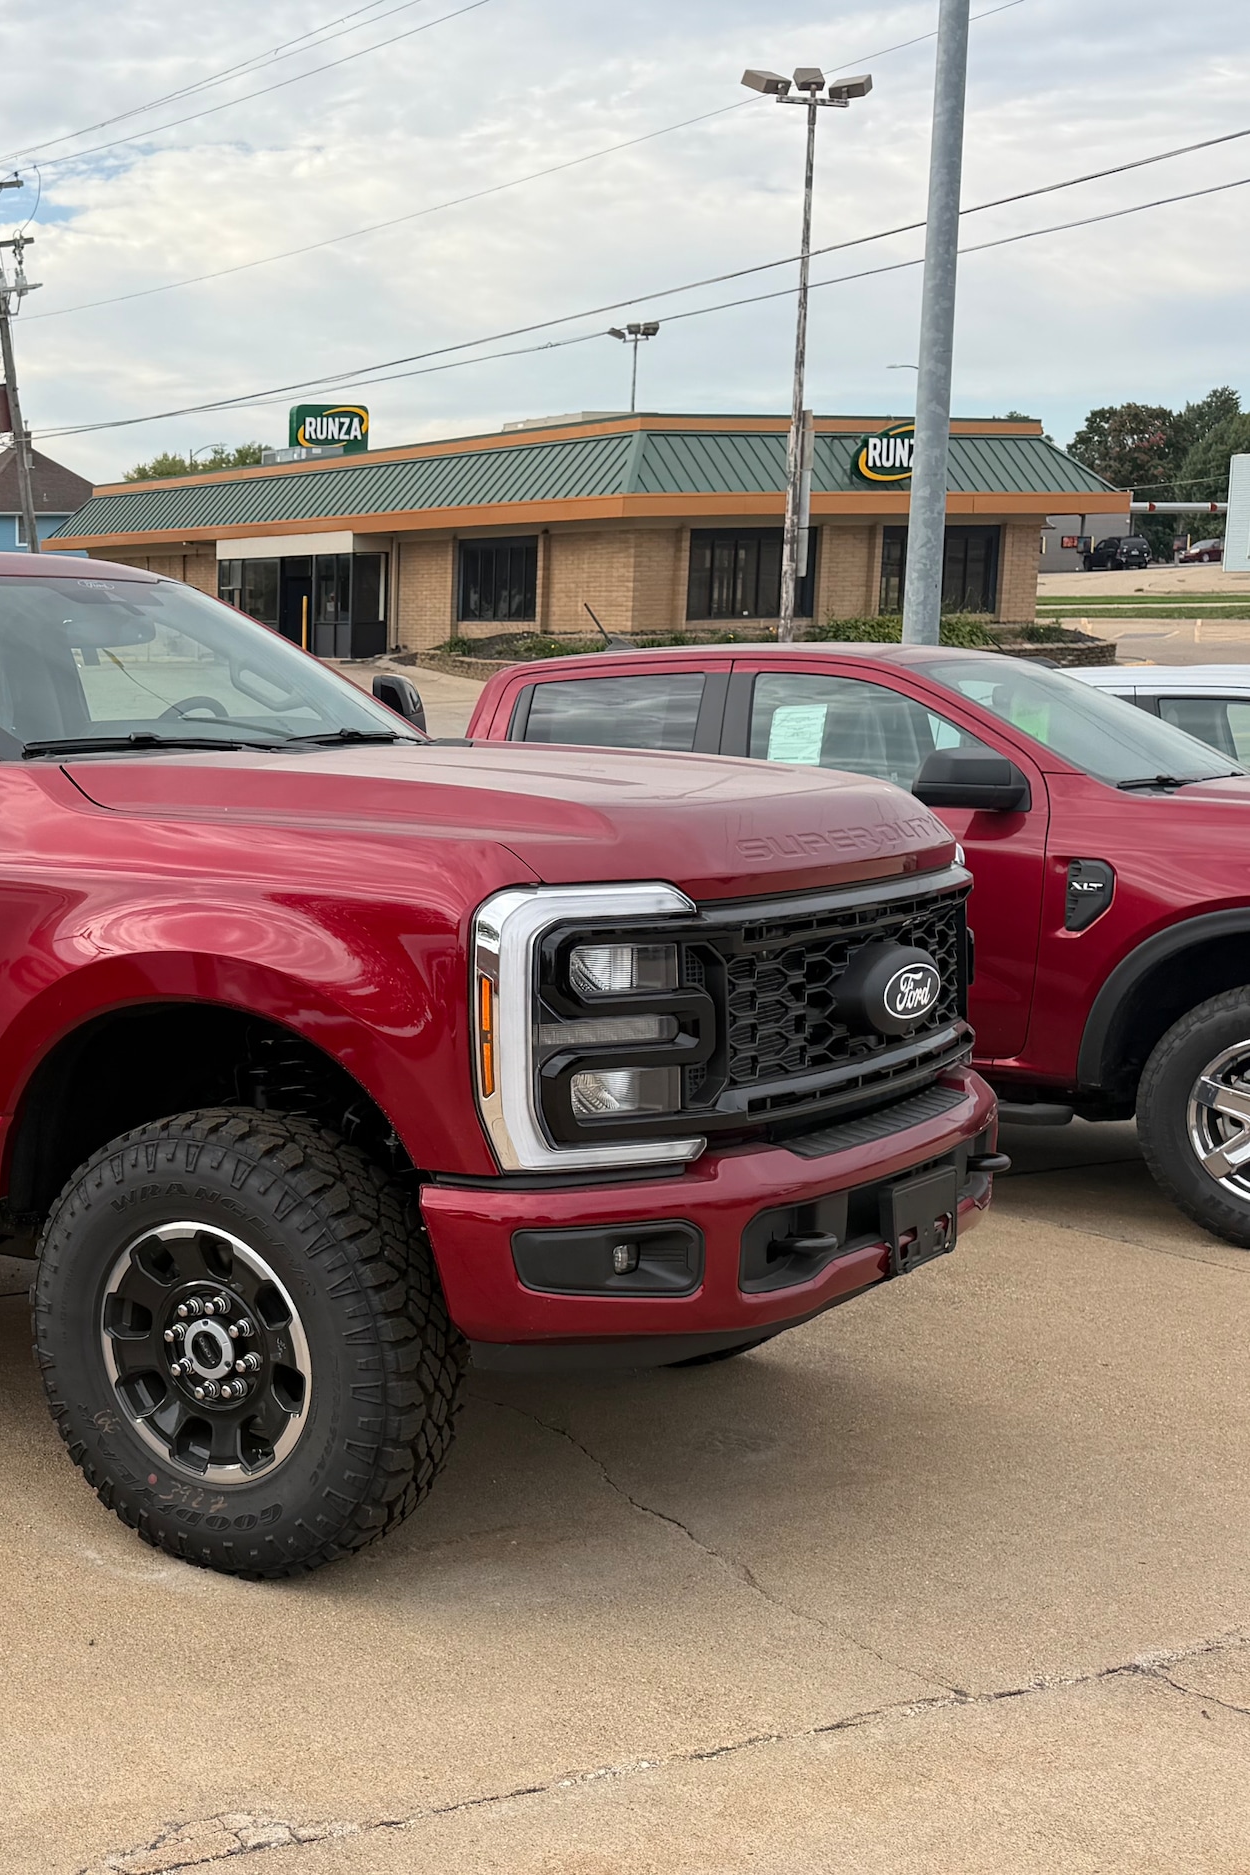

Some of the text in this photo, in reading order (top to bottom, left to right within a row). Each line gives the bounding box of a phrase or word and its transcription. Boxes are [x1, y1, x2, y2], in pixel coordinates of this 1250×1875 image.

[305, 417, 362, 440] RUNZA
[736, 815, 941, 862] SUPER DUTY
[1070, 881, 1104, 893] XLT
[895, 971, 932, 1012] Ford
